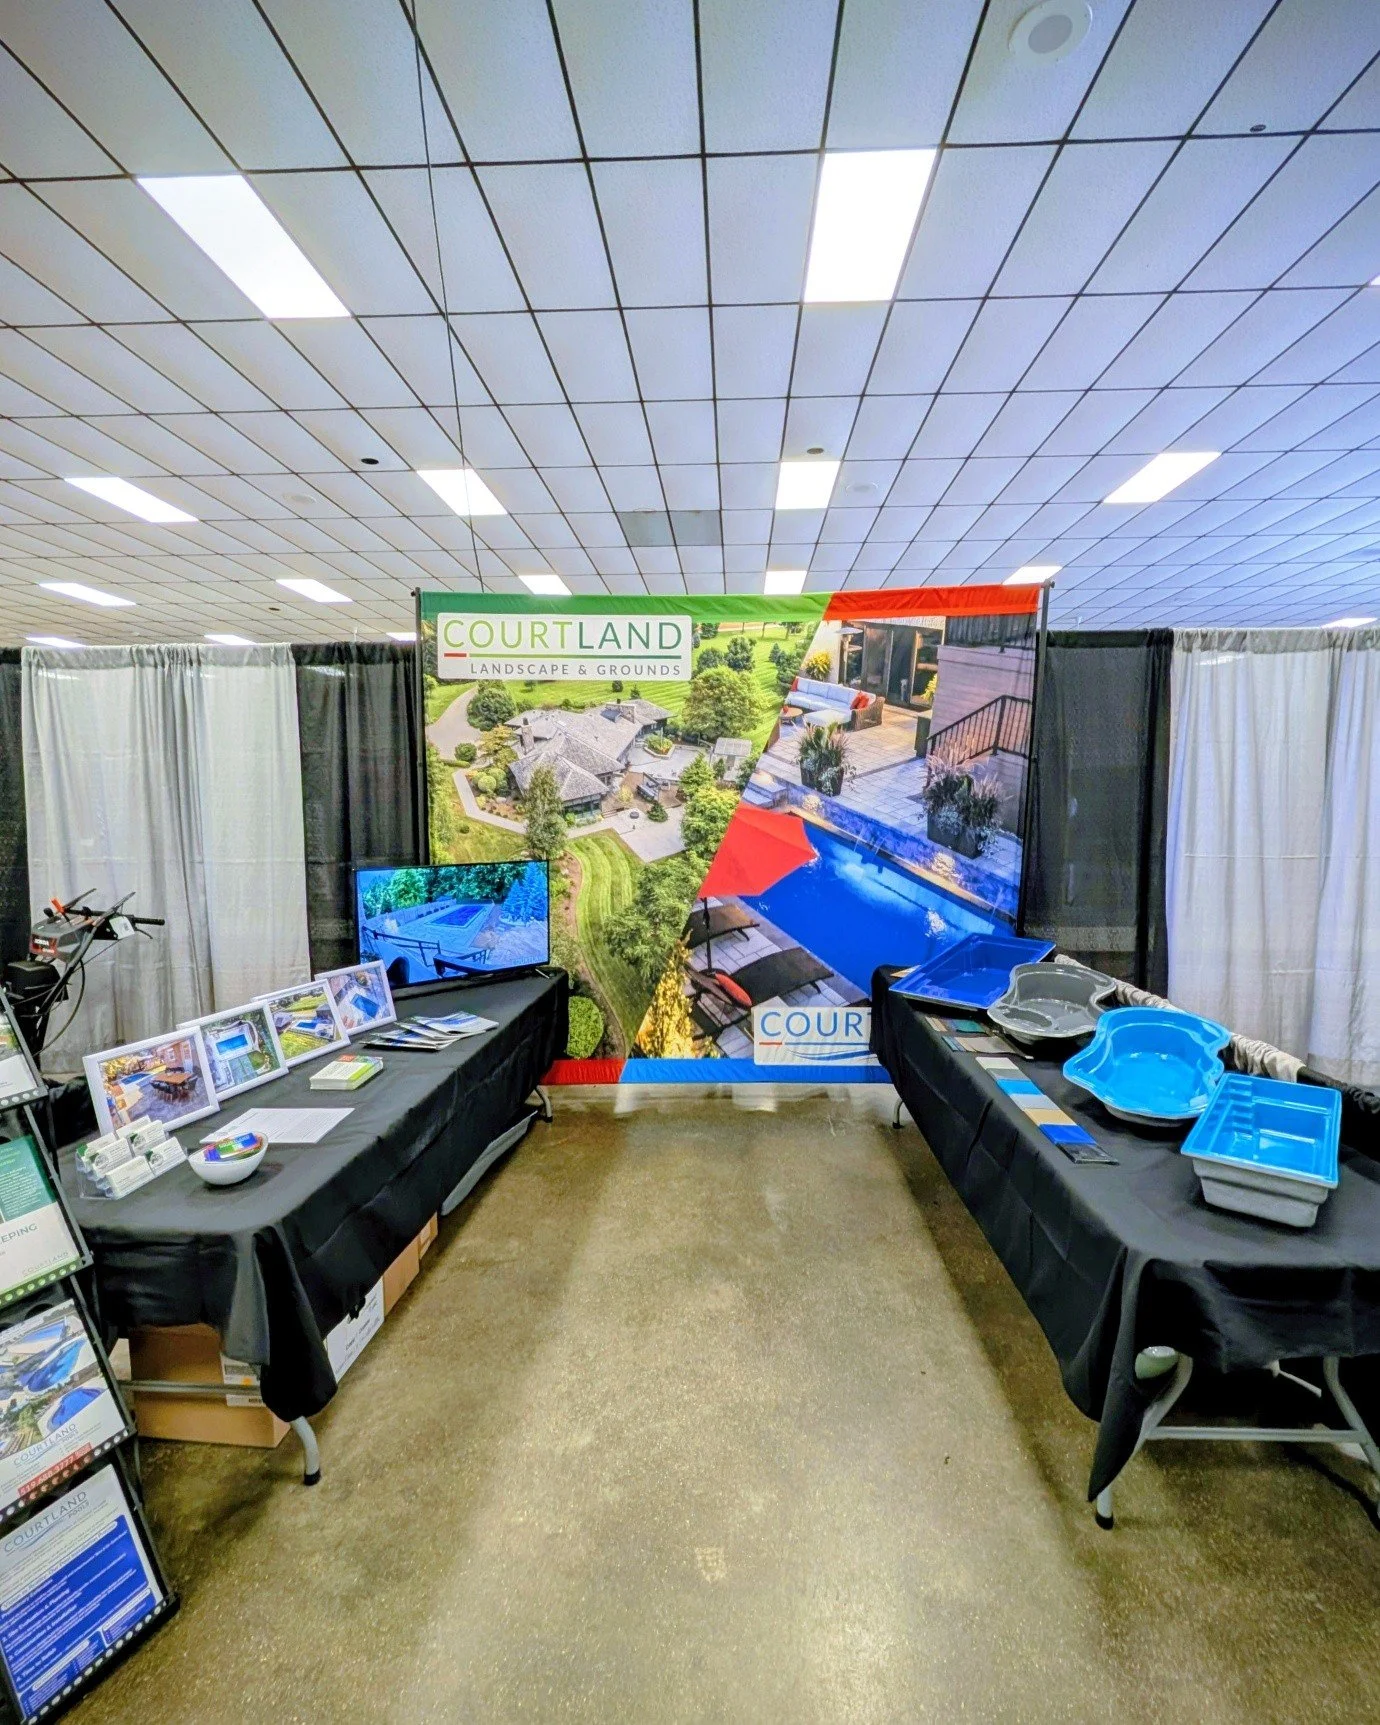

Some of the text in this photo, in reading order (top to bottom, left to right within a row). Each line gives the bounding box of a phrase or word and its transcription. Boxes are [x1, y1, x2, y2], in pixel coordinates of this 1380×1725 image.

[443, 620, 682, 650] COURTLAND
[470, 663, 681, 676] LANDSCAPE & GROUNDS
[760, 1011, 872, 1037] COUR
[0, 1223, 38, 1244] EPING
[13, 1423, 76, 1465] COURTLAND
[4, 1491, 87, 1553] COURTLAND
[67, 1501, 90, 1518] POOLS
